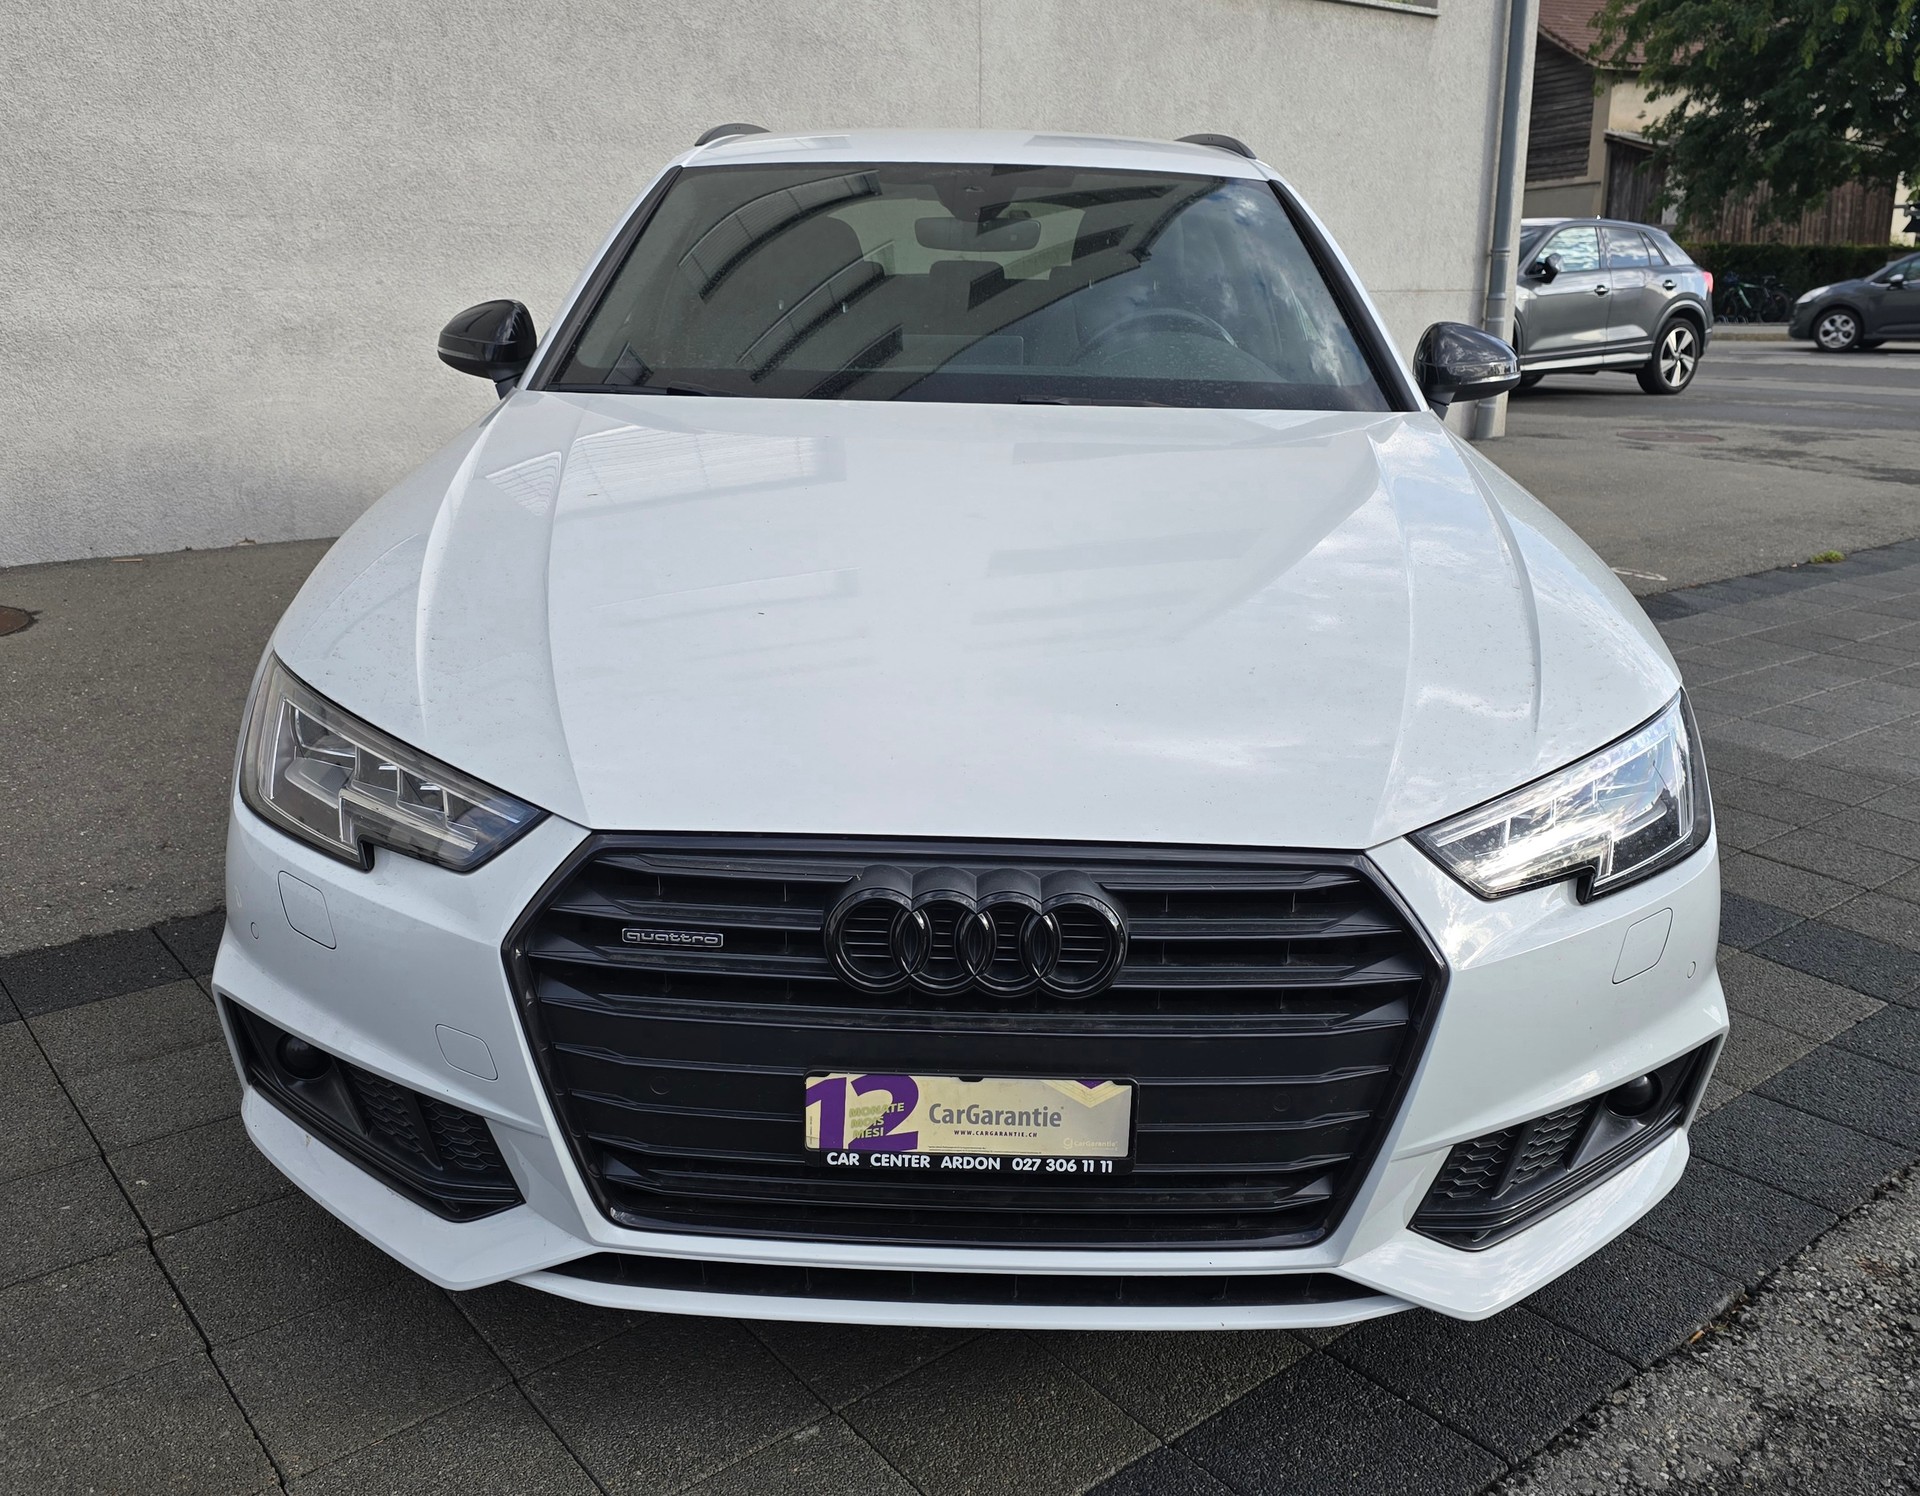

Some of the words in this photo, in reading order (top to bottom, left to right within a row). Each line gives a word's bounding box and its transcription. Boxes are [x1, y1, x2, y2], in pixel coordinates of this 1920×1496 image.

[626, 932, 718, 944] quattro
[805, 1074, 919, 1151] 12
[849, 1102, 905, 1118] MONATE
[928, 1103, 1062, 1127] CarGarantie
[851, 1116, 885, 1129] MOIS
[853, 1127, 884, 1139] MESI
[953, 1130, 1038, 1138] WWW.CARGARANTIE.CH
[826, 1152, 860, 1166] CAR
[870, 1153, 931, 1168] CENTER
[940, 1156, 1001, 1170] ARDON
[1011, 1158, 1042, 1172] 027
[1045, 1159, 1077, 1172] 306
[1081, 1160, 1094, 1173] 11
[1100, 1160, 1113, 1173] 11
